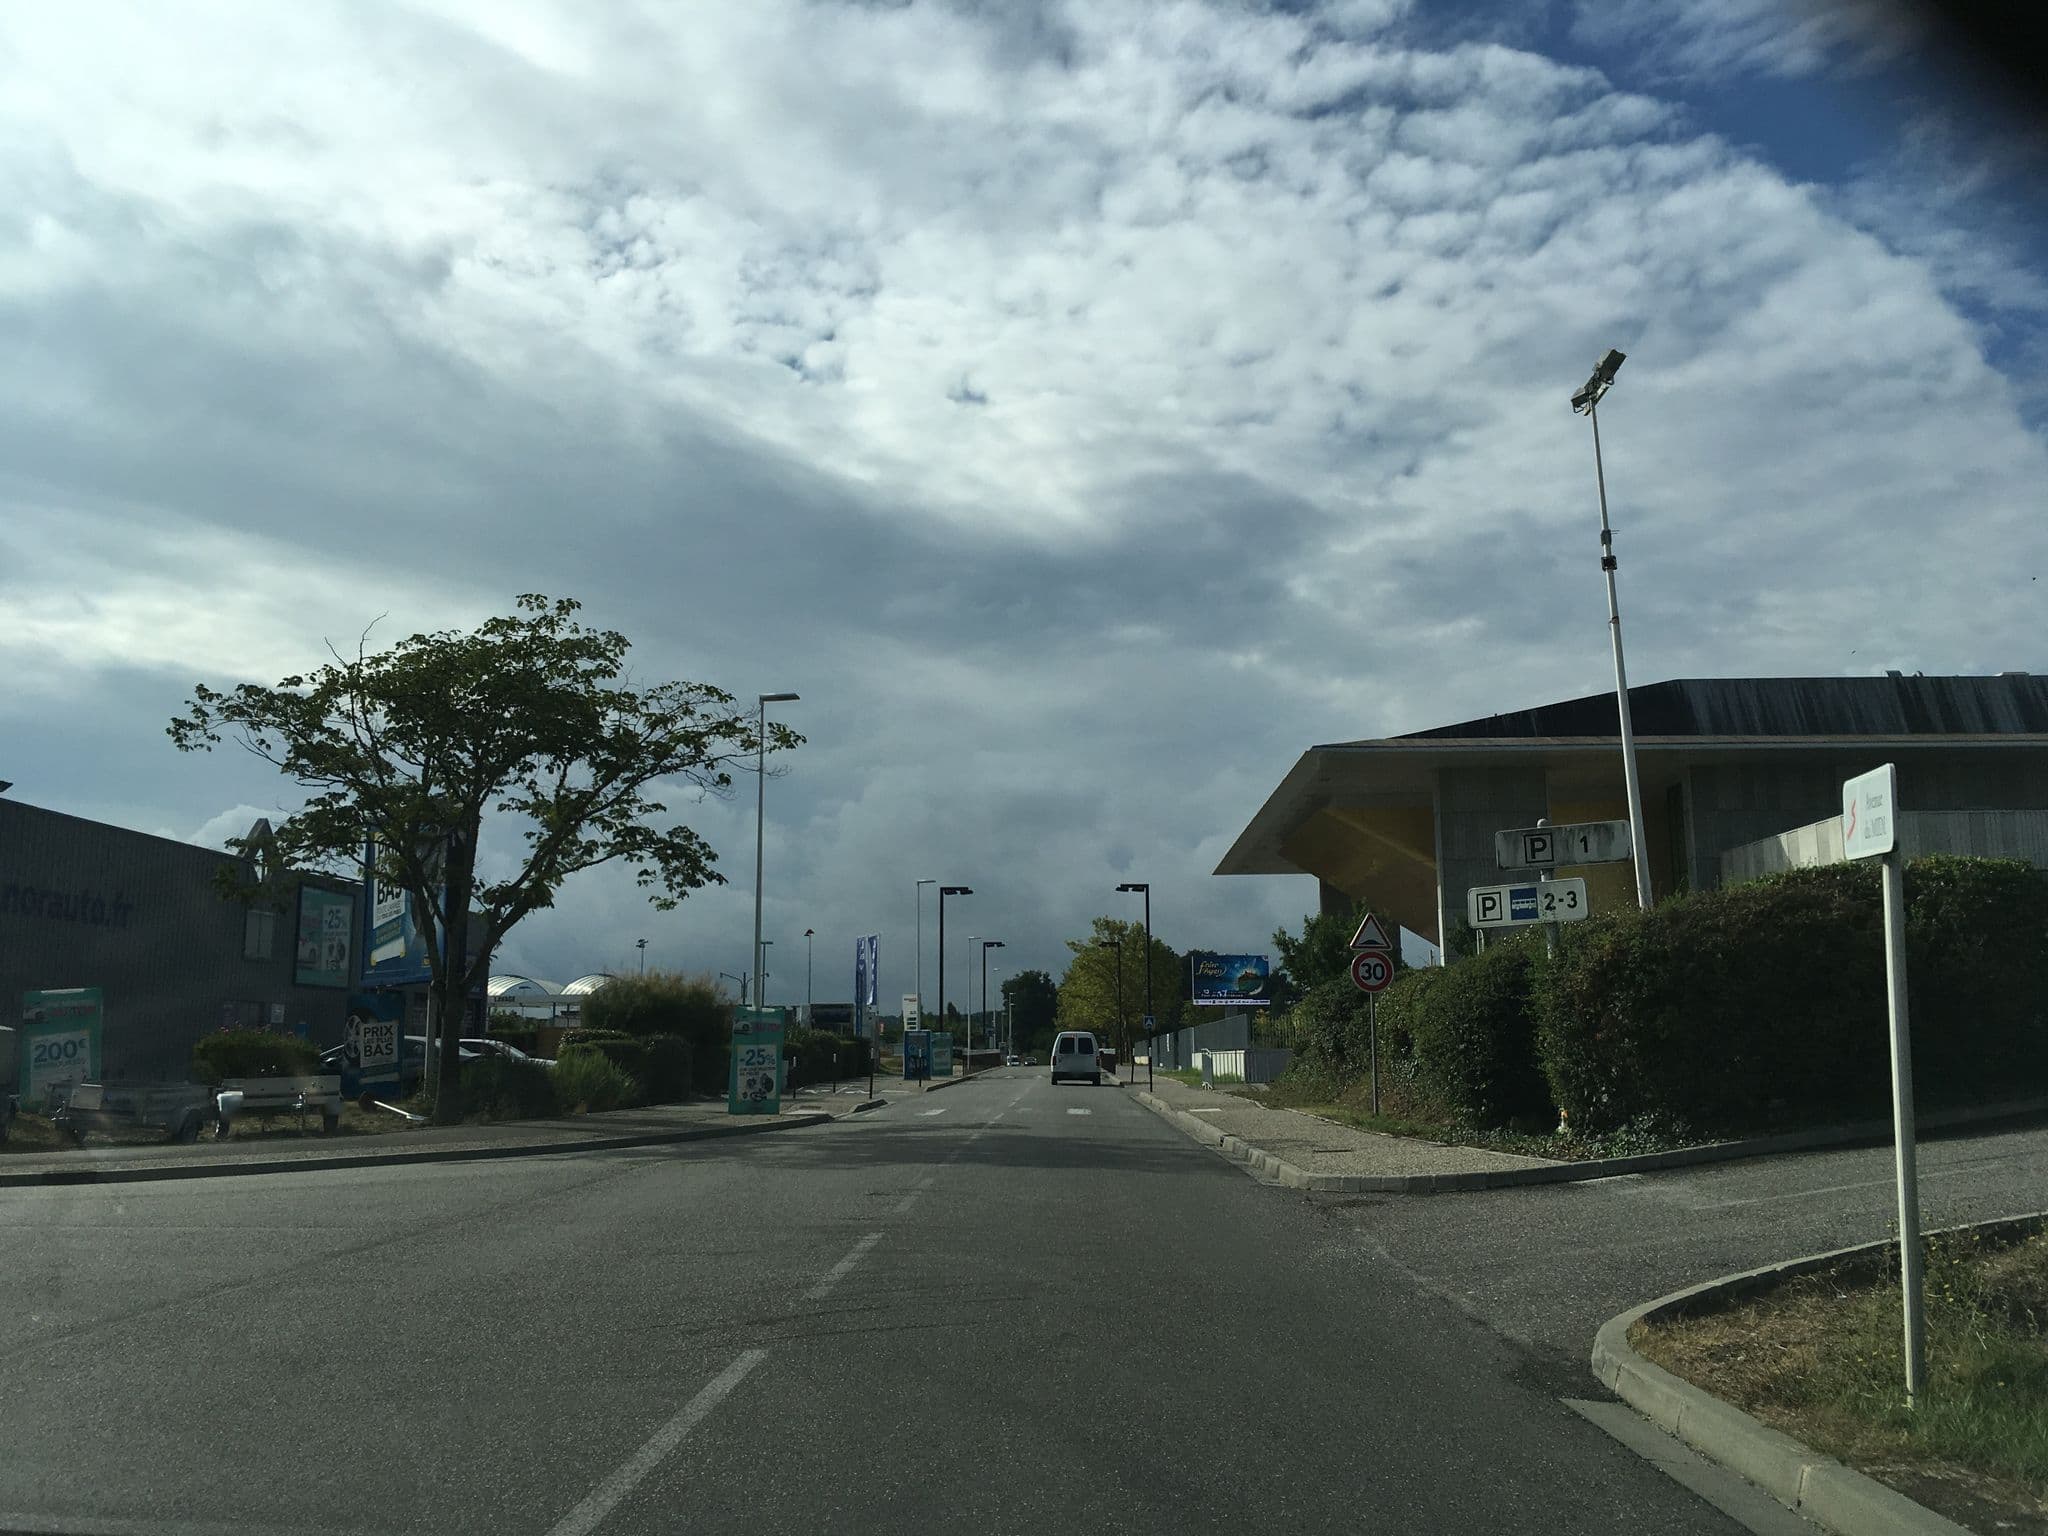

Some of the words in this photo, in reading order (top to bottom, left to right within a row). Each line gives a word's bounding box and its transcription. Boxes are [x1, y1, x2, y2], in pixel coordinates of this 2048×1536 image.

[1529, 837, 1547, 859] P
[1579, 835, 1589, 853] 1
[1481, 896, 1497, 918] P
[1543, 890, 1578, 911] 2-3
[1361, 962, 1385, 980] 30
[363, 1025, 394, 1038] PRIX
[363, 1042, 394, 1057] BAS
[740, 1048, 776, 1067] -25%
